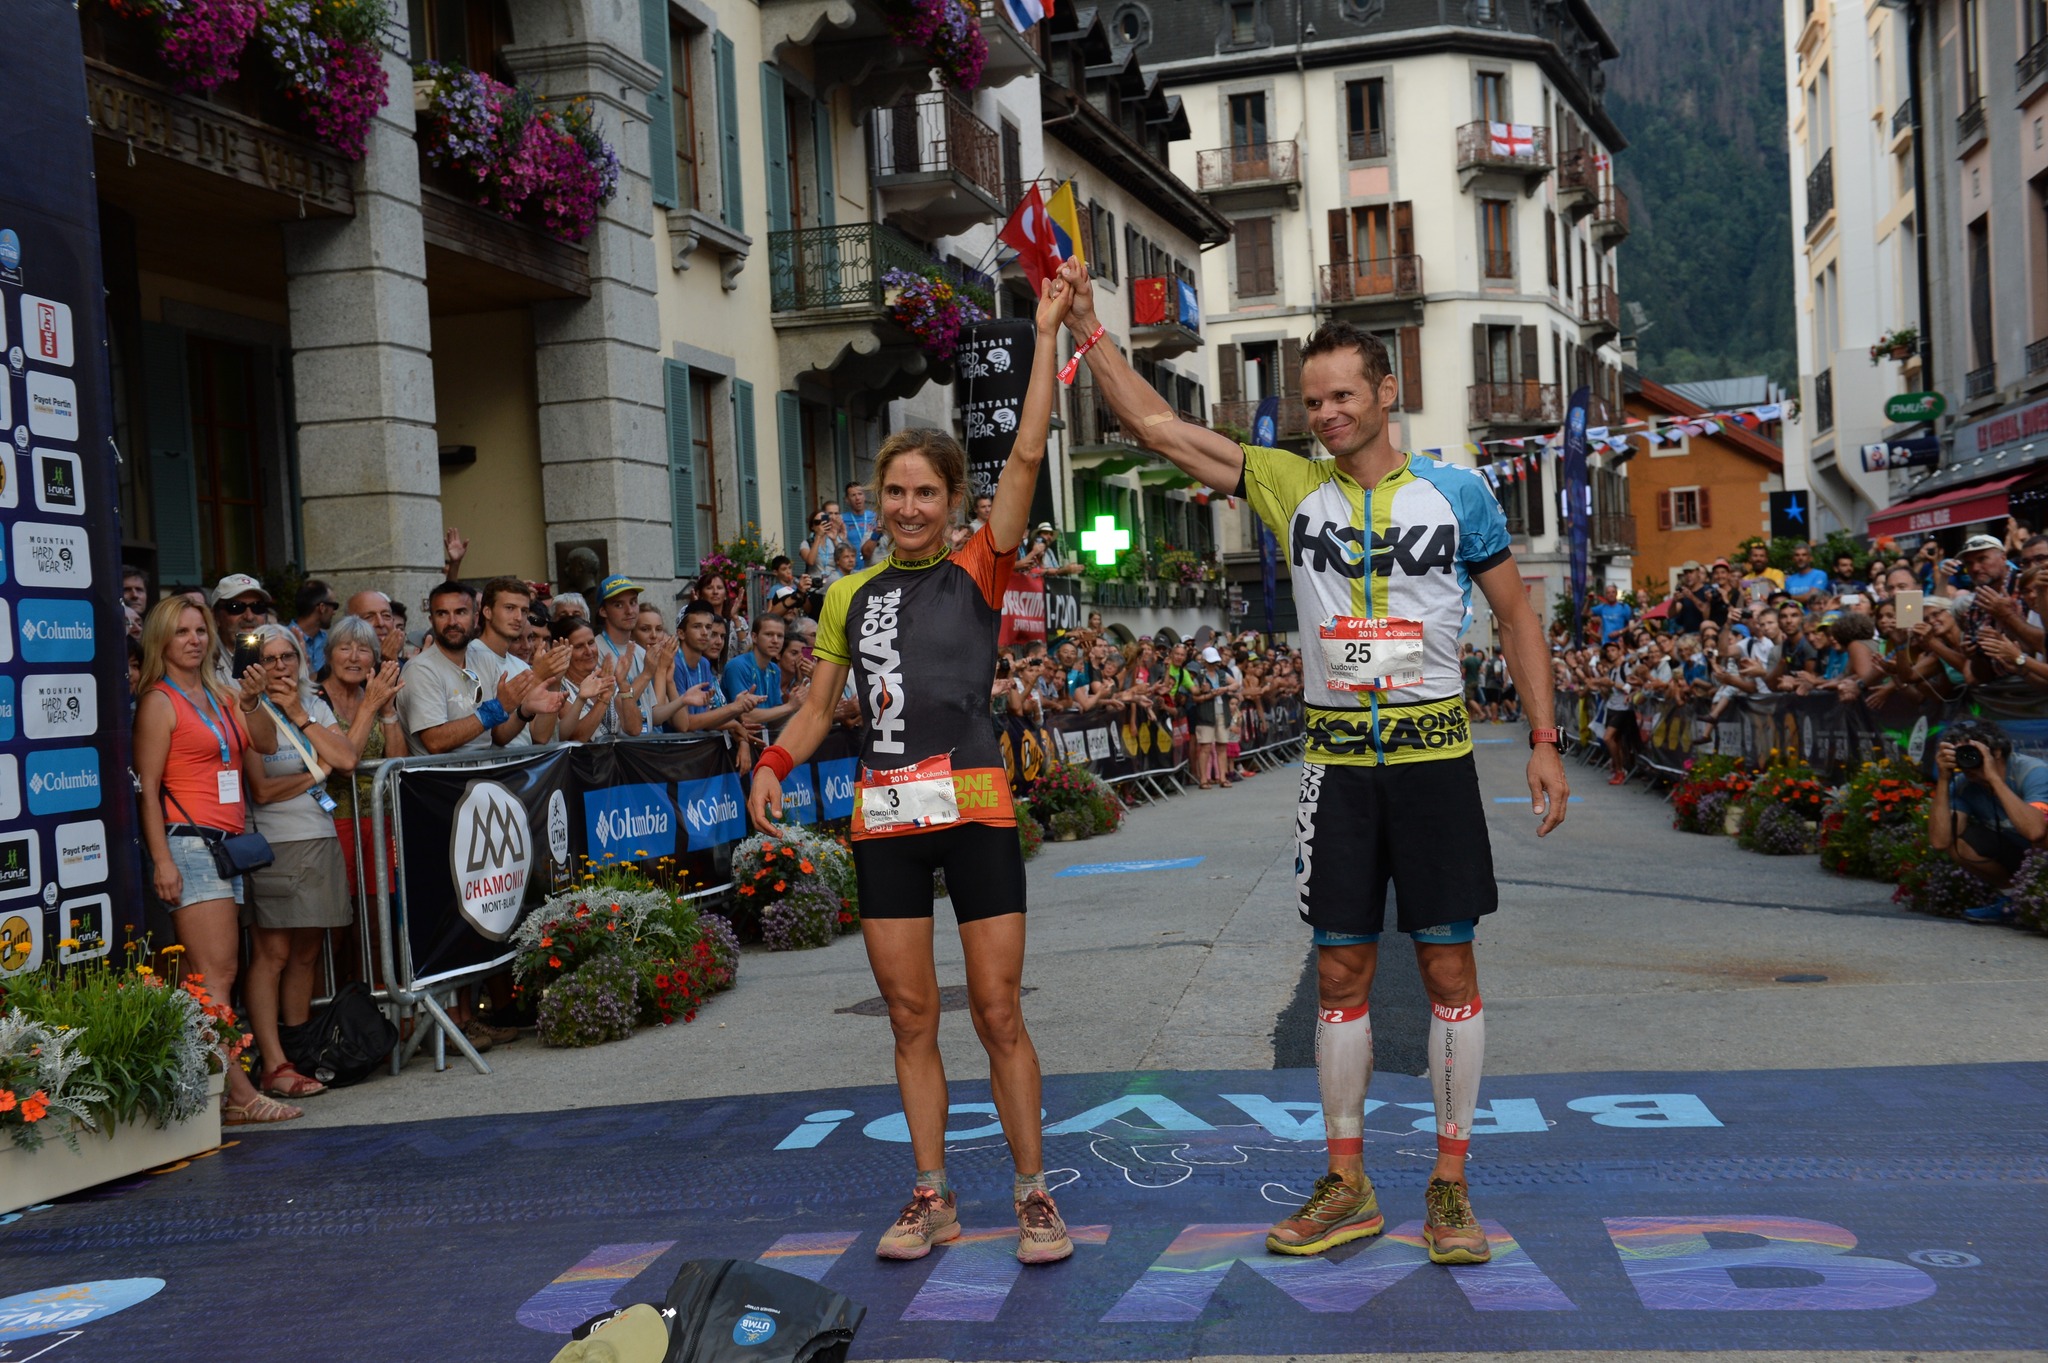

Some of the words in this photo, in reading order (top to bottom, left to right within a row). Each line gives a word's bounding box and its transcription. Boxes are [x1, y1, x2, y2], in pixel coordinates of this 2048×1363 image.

[43, 307, 54, 354] OutDry
[33, 394, 52, 406] Payot
[53, 398, 72, 409] Pertin
[1891, 403, 1918, 415] PMU
[970, 460, 1006, 471] OUNTA
[48, 484, 72, 495] i-run.fr
[29, 536, 74, 546] MOUNTAIN
[1293, 514, 1455, 578] HOKA
[32, 546, 54, 560] HARD
[38, 560, 60, 574] WEAR
[861, 596, 883, 636] ONE
[880, 587, 902, 630] ONE
[36, 620, 93, 640] Columbia
[1358, 630, 1378, 638] 2016
[1344, 642, 1371, 663] 25
[1330, 663, 1359, 671] Ludovic
[39, 687, 82, 695] MOUNTAIN
[859, 627, 905, 754] HOKA
[42, 697, 62, 711] HARD
[47, 711, 68, 724] WEAR
[1416, 706, 1463, 732] ONE
[1305, 715, 1427, 754] HOKA
[1424, 722, 1468, 748] ONE
[43, 769, 98, 791] Columbia
[890, 774, 909, 783] 2016
[921, 770, 950, 779] Columbia
[953, 774, 993, 793] ONE
[888, 788, 900, 808] 3
[957, 790, 998, 809] ONE
[870, 808, 899, 817] Caroline
[609, 808, 668, 841] Columbia
[551, 828, 566, 844] UTMB
[62, 846, 80, 856] Payot
[81, 843, 100, 854] Pertin
[465, 869, 525, 901] CHAMONIX
[481, 895, 516, 914] MONT-BLANC
[77, 930, 99, 942] run.fr
[1445, 1027, 1454, 1121] COMPRESSPORT
[742, 1318, 770, 1331] UTMB
